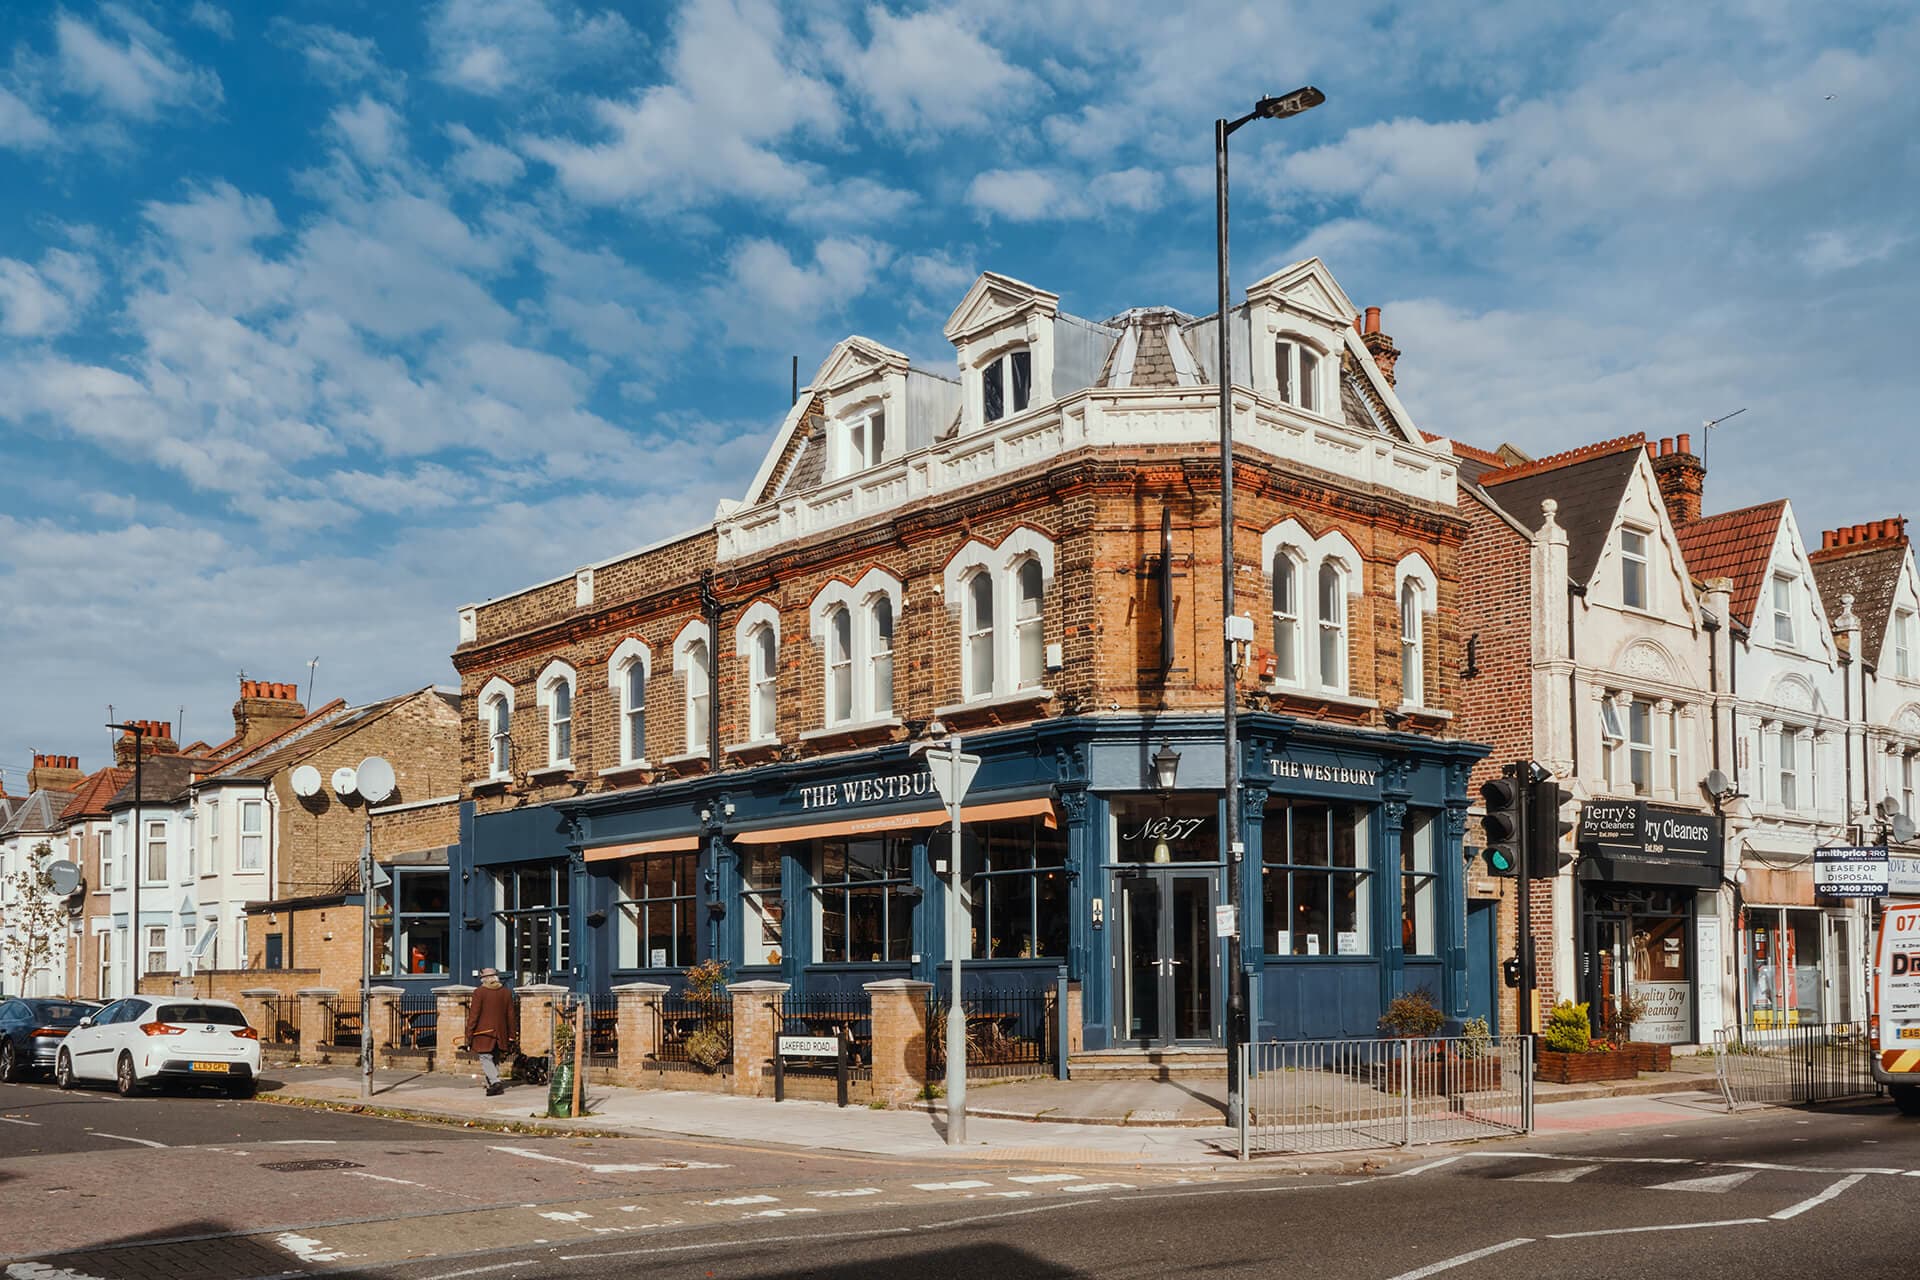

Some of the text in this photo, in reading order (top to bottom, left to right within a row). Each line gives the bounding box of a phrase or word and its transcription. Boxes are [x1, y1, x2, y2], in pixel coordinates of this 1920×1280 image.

[1270, 759, 1376, 786] THE WESTBURY
[800, 784, 838, 809] THE
[1585, 805, 1636, 822] Terry's
[1585, 821, 1635, 831] Dry Cleaners
[1663, 819, 1709, 841] Cleaners
[1668, 988, 1685, 1004] Dry
[1643, 1003, 1679, 1019] leaning
[782, 1040, 811, 1050] LAKEFIELD
[813, 1041, 830, 1051] ROAD
